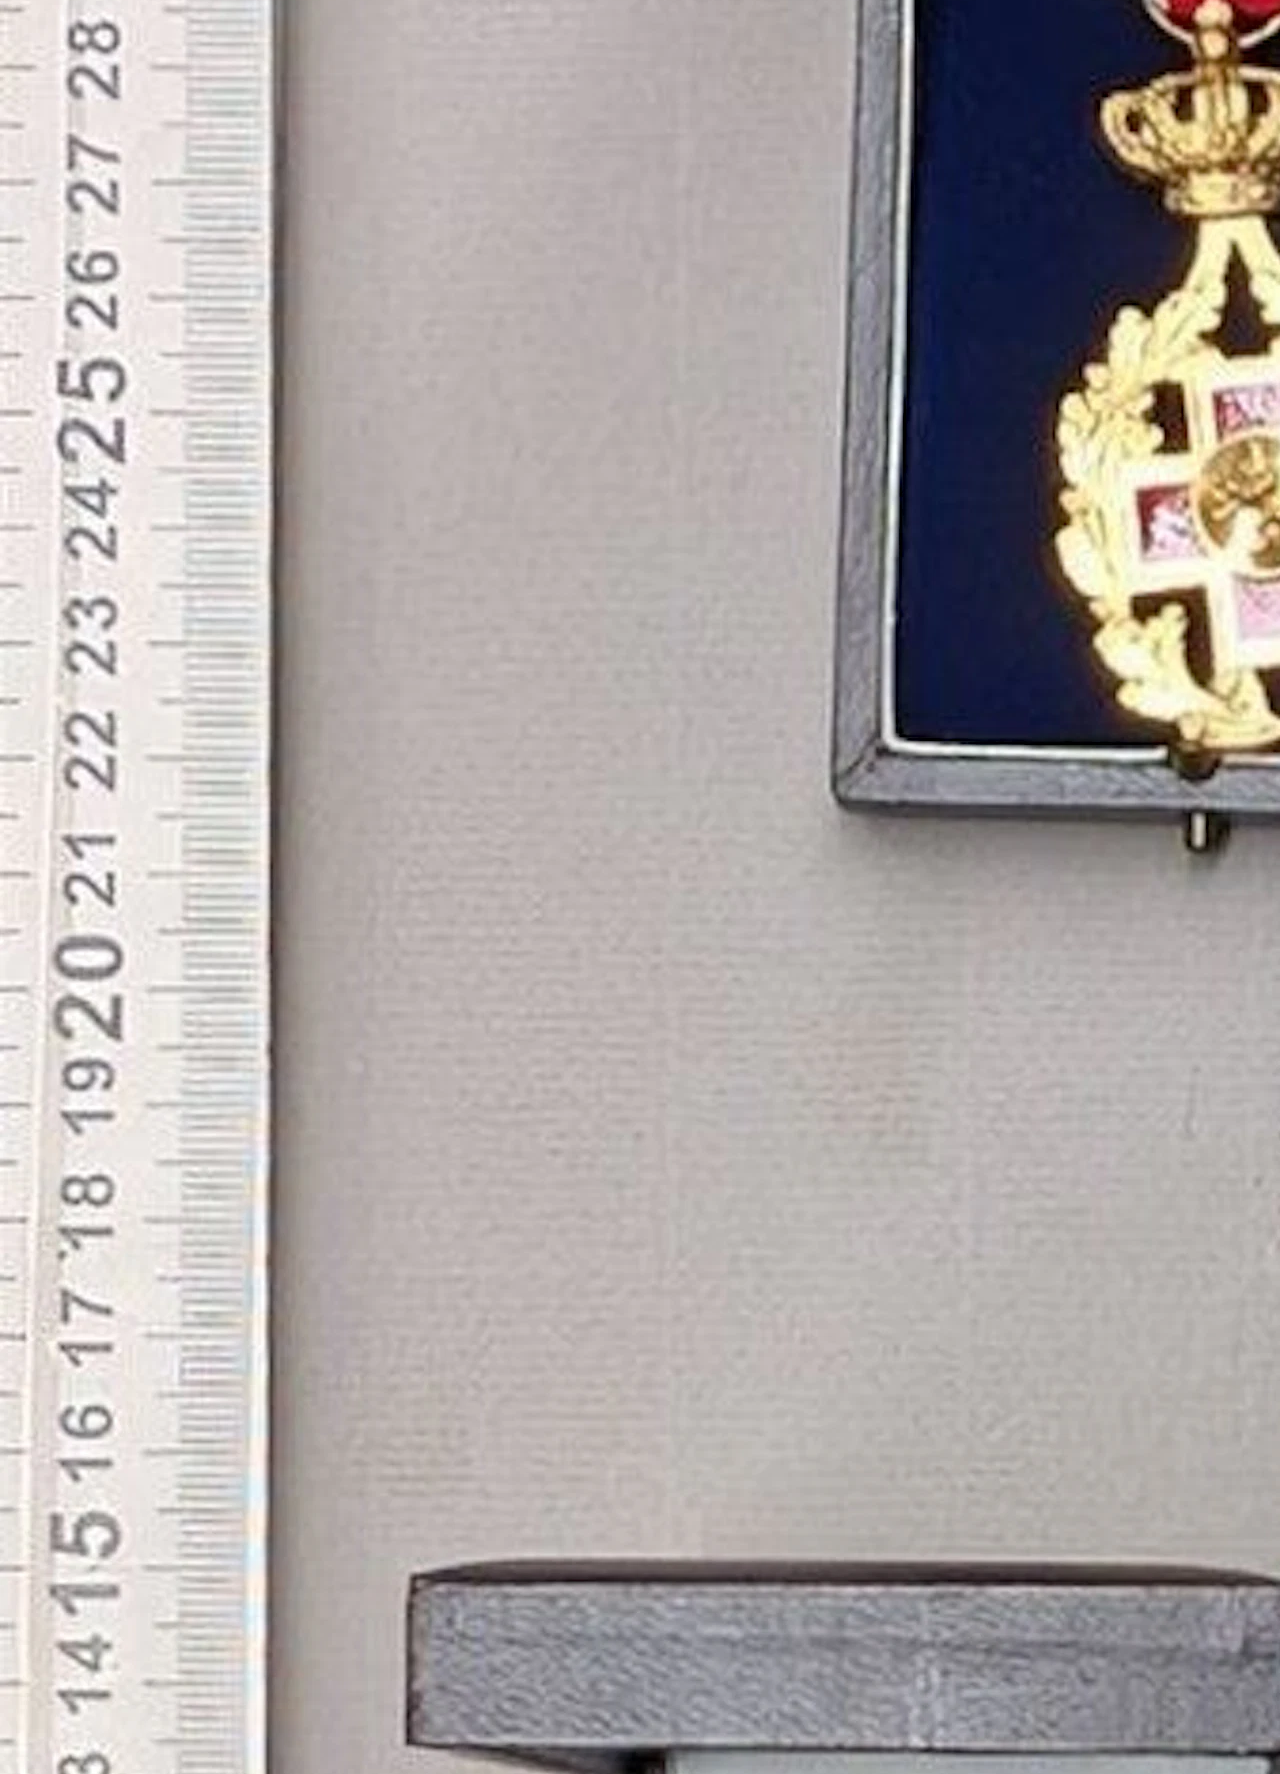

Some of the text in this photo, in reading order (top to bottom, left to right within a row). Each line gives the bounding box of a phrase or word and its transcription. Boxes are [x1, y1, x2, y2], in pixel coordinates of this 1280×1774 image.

[66, 21, 120, 100] 28
[66, 134, 120, 214] 27
[65, 251, 119, 330] 26
[56, 358, 126, 464] 25
[63, 479, 118, 560] 24
[61, 597, 117, 675] 23
[63, 712, 116, 791] 22
[62, 835, 115, 907] 21
[52, 936, 123, 1041] 20
[60, 1059, 114, 1135] 19
[57, 1174, 114, 1250] 18
[58, 1289, 113, 1366] 17
[58, 1405, 113, 1482] 16
[48, 1512, 120, 1615] 15
[57, 1636, 111, 1714] 14
